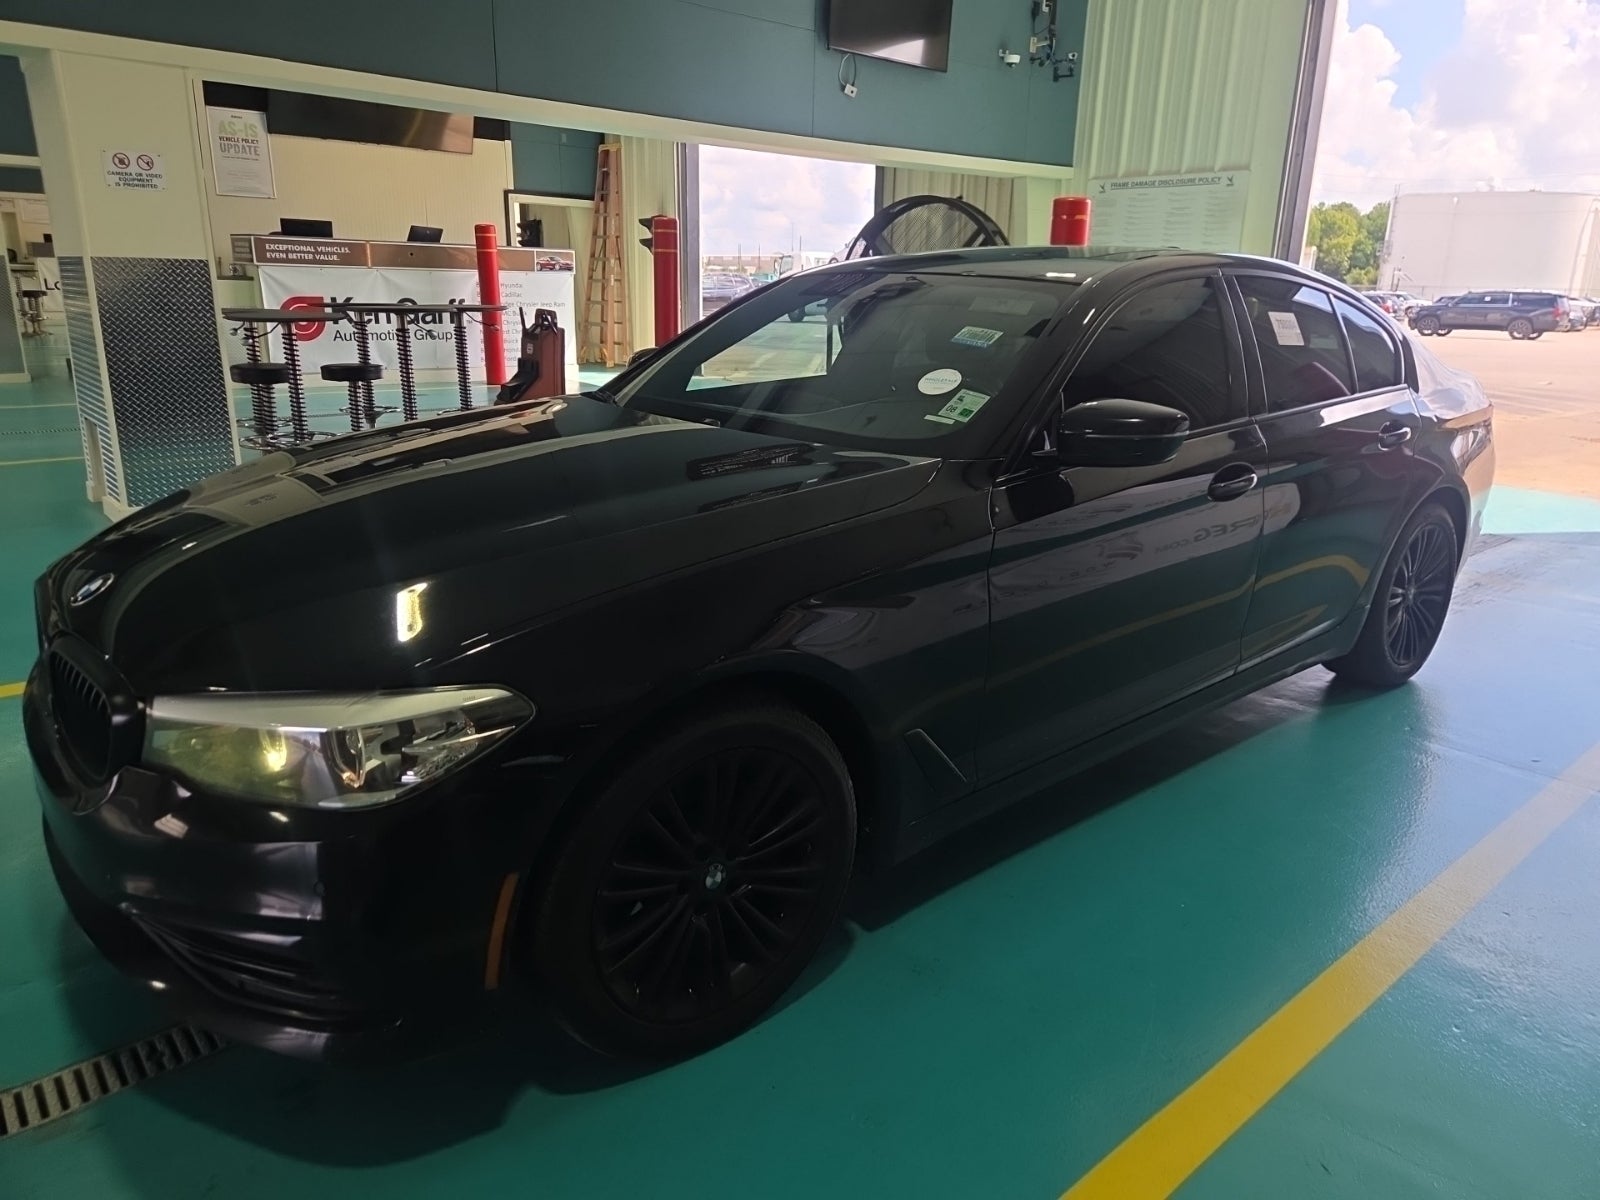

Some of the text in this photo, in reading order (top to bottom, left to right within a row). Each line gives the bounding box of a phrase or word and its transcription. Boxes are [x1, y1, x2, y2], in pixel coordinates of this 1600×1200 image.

[218, 121, 257, 138] AS-IS
[219, 142, 260, 156] UPDATE
[1158, 178, 1198, 186] DISCLOSURE
[265, 243, 351, 254] EXCEPTIONAL VEHICLES.
[333, 329, 453, 343] Autmoti Grup
